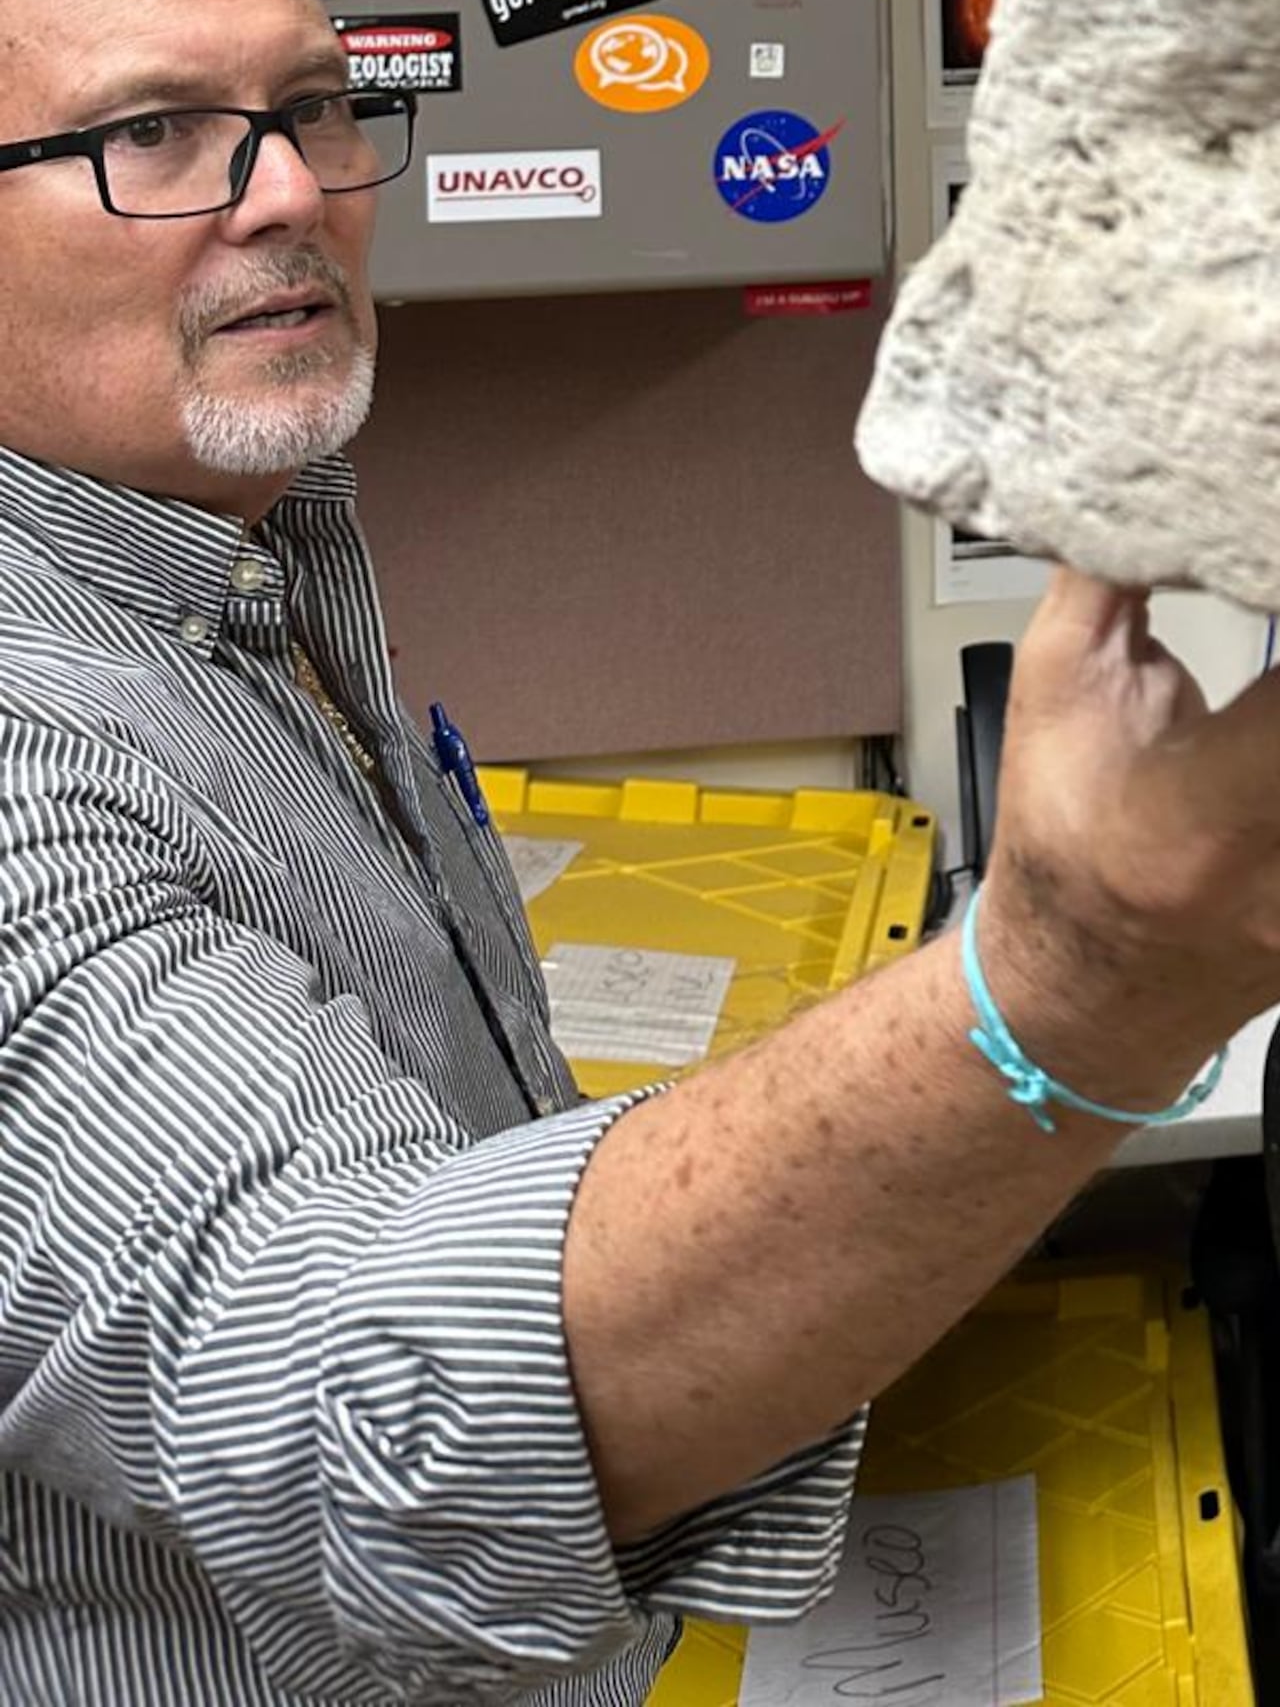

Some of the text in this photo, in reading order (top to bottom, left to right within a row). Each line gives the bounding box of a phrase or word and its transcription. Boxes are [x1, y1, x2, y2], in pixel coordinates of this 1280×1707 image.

[345, 31, 437, 50] WARNING
[348, 50, 455, 80] EOLOGIST
[437, 165, 585, 193] UNAVCO
[723, 152, 825, 182] NASA
